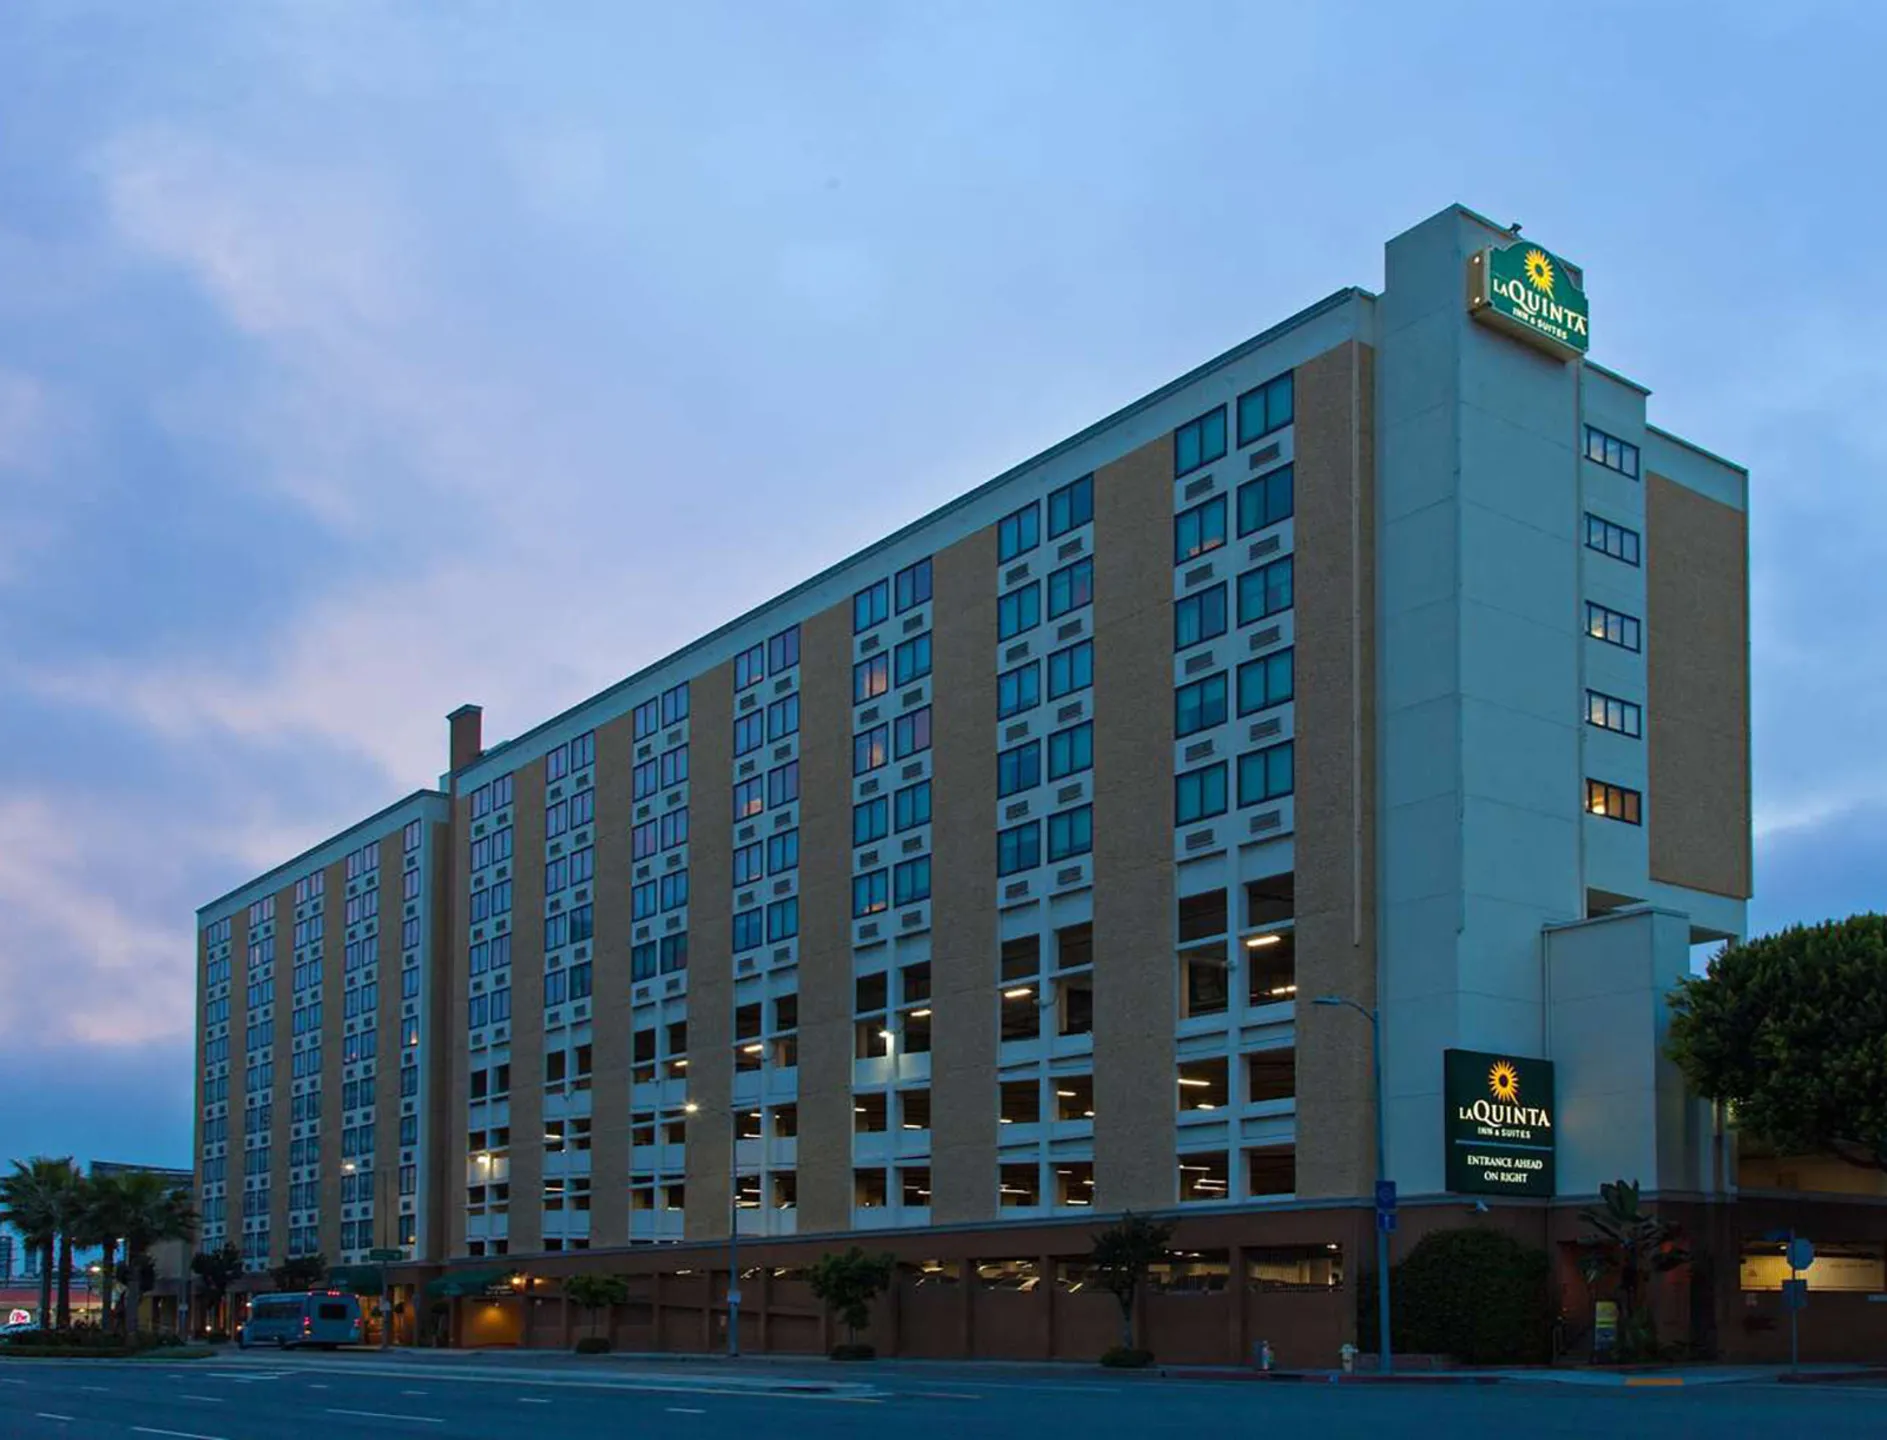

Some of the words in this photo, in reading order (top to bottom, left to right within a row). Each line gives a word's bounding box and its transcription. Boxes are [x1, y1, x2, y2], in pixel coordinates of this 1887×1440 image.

[1512, 307, 1529, 321] INN
[1537, 319, 1568, 340] SUITES
[1477, 1127, 1493, 1136] INN
[1494, 1128, 1500, 1137] &
[1501, 1128, 1531, 1139] SUITES
[1467, 1155, 1512, 1168] ENTRANCE
[1514, 1158, 1543, 1170] AHEAD
[1484, 1171, 1499, 1181] ON
[1500, 1172, 1528, 1183] RIGHT
